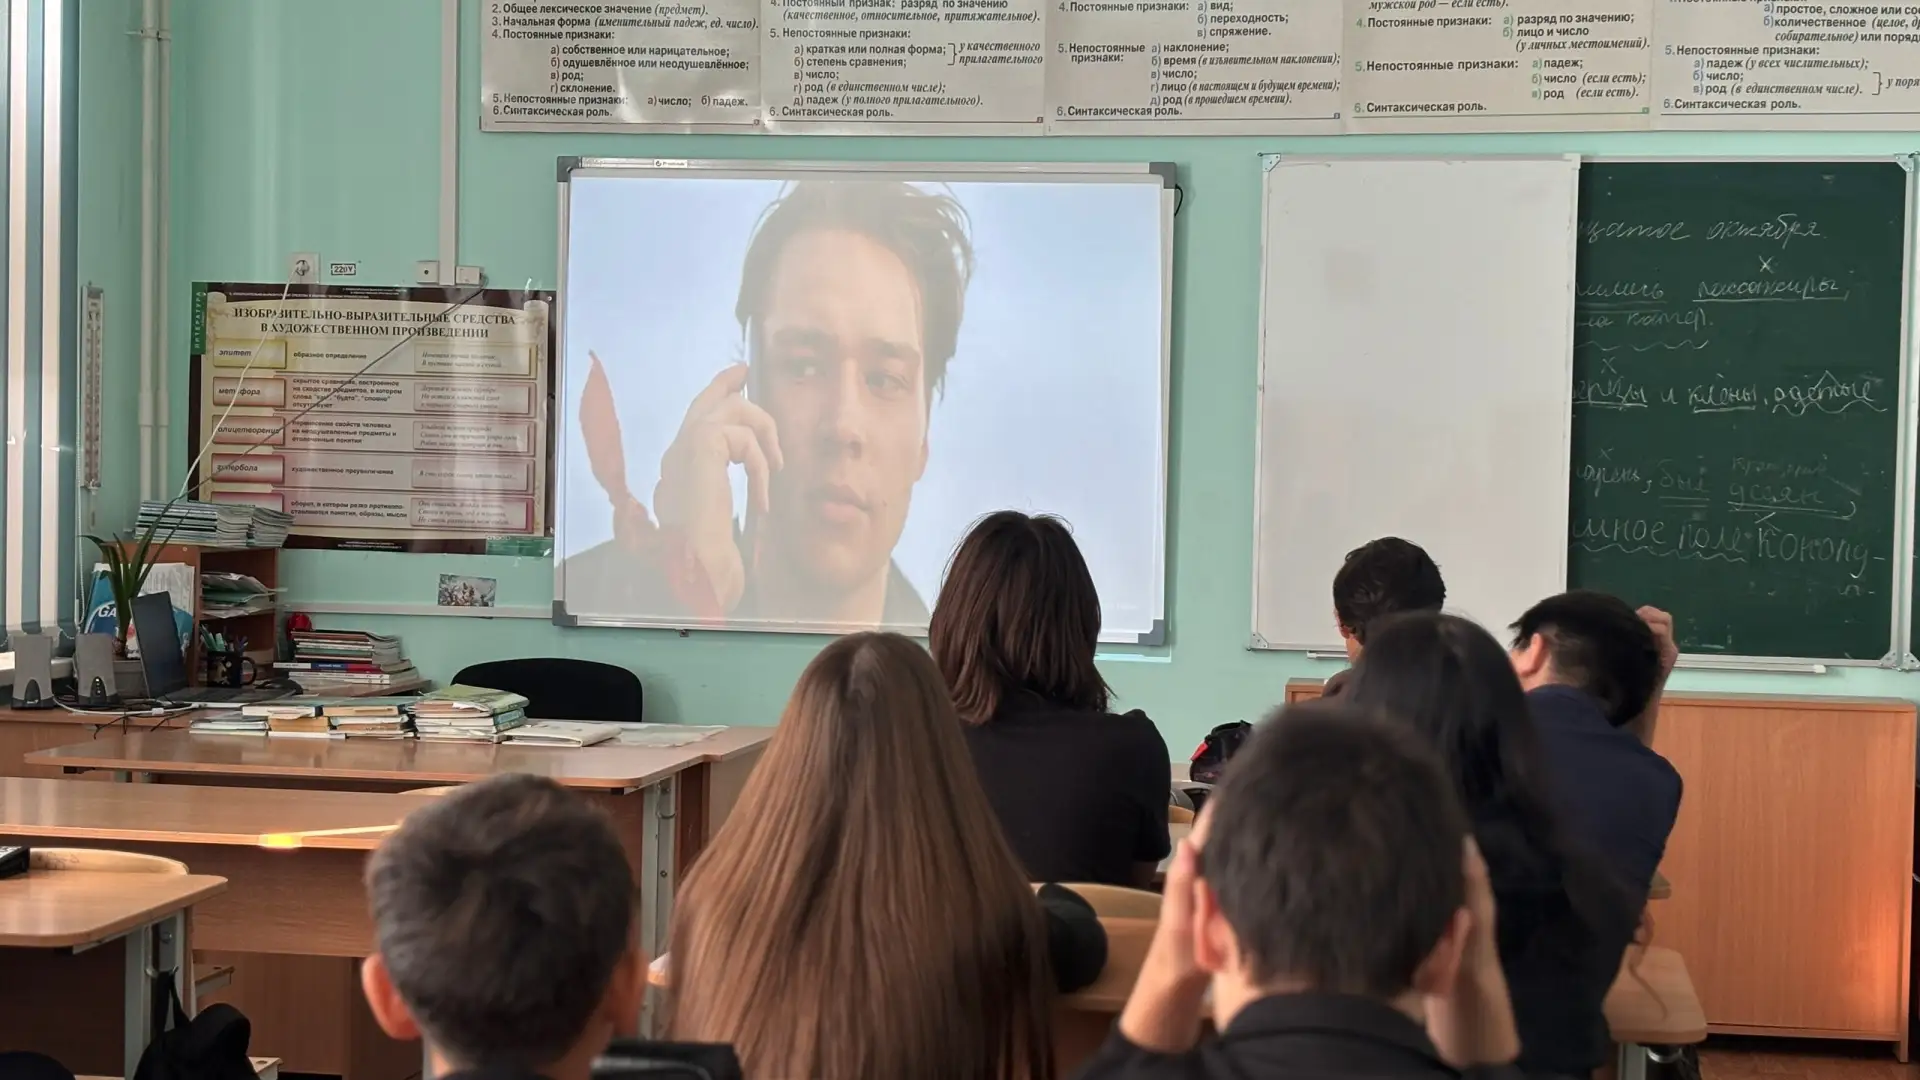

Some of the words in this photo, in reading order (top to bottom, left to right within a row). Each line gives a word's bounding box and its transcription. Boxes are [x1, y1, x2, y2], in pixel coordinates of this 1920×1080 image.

[503, 5, 538, 15] Общее
[539, 6, 602, 16] лексическое
[604, 6, 652, 15] значение
[655, 5, 708, 16] (предмет).
[1070, 1, 1134, 12] Постоянные
[1136, 3, 1189, 13] признаки:
[1210, 2, 1233, 12] вид;
[1776, 5, 1827, 16] простое,
[1829, 6, 1878, 16] сложное
[1881, 7, 1902, 16] или
[783, 10, 858, 22] (качественное,
[861, 12, 940, 22] относительное,
[944, 10, 1040, 23] притяжательное).
[1210, 14, 1288, 25] переходность;
[1368, 18, 1434, 27] Постоянные
[1437, 17, 1491, 27] признаки:
[1517, 16, 1557, 27] разряд
[1559, 15, 1573, 23] по
[1575, 14, 1634, 24] значению;
[503, 17, 555, 26] Начальная
[557, 17, 590, 28] форма
[595, 17, 671, 27] (именительный
[673, 17, 707, 29] падеж,
[710, 17, 723, 28] ед.
[726, 18, 760, 29] число).
[1773, 19, 1866, 28] количественное
[1872, 17, 1908, 29] (целое,
[503, 30, 563, 39] Постоянные
[565, 31, 615, 41] признаки:
[783, 28, 857, 38] Непостоянные
[859, 30, 910, 39] признаки:
[1209, 28, 1271, 38] спряжение.
[1517, 28, 1544, 38] лицо
[1556, 28, 1589, 36] число
[1775, 30, 1859, 43] собирательное)
[964, 43, 1040, 51] качественного
[1069, 43, 1145, 53] Непостоянные
[1164, 44, 1229, 53] наклонение;
[1528, 41, 1566, 50] личных
[1568, 38, 1650, 50] местоимений).
[562, 45, 626, 54] собственное
[626, 47, 646, 56] или
[649, 47, 729, 57] нарицательное;
[806, 46, 846, 56] краткая
[848, 46, 867, 54] или
[869, 46, 905, 54] полная
[906, 44, 946, 56] форма;
[1677, 45, 1759, 55] Непостоянные
[1762, 47, 1820, 56] признаки:
[563, 58, 636, 69] одушевлённое
[638, 60, 657, 68] или
[660, 59, 749, 70] неодушевлённое;
[807, 59, 847, 67] степень
[849, 59, 906, 68] сравнения;
[959, 56, 1043, 66] прилагательного
[1071, 54, 1124, 63] признаки:
[1164, 57, 1196, 67] время
[1280, 53, 1340, 65] наклонении);
[1706, 60, 1743, 69] падеж
[1758, 60, 1781, 68] всех
[1784, 58, 1869, 70] числительных);
[1367, 61, 1454, 71] Непостоянные
[1457, 60, 1518, 71] признаки:
[1544, 60, 1583, 69] падеж;
[562, 72, 584, 82] род;
[806, 71, 839, 80] число;
[1163, 70, 1197, 80] число;
[1544, 75, 1577, 83] число
[1582, 72, 1610, 85] (если
[1612, 72, 1646, 84] есть);
[1706, 72, 1743, 82] число;
[560, 85, 615, 93] склонение.
[804, 84, 823, 93] род
[838, 82, 909, 92] единственном
[912, 82, 946, 94] числе);
[1161, 84, 1187, 93] лицо
[1297, 81, 1340, 93] времени);
[1544, 90, 1564, 99] род
[1576, 86, 1604, 99] (если
[1605, 86, 1639, 99] есть).
[1705, 85, 1728, 96] род
[1746, 83, 1823, 94] единственном
[1826, 83, 1863, 96] числе).
[504, 94, 576, 104] Непостоянные
[579, 97, 628, 106] признаки:
[658, 98, 691, 107] число;
[713, 99, 748, 107] падеж.
[805, 95, 838, 106] падеж
[853, 96, 891, 104] полного
[893, 95, 983, 107] прилагательного).
[1163, 96, 1182, 106] род
[1248, 93, 1292, 106] времени).
[1674, 99, 1767, 109] Синтаксическая
[1770, 101, 1801, 110] роль.
[503, 106, 584, 116] Синтаксическая
[586, 109, 612, 118] роль.
[782, 107, 864, 116] Синтаксическая
[866, 109, 893, 119] роль.
[1068, 106, 1152, 116] Синтаксическая
[1154, 107, 1182, 117] роль.
[1367, 102, 1455, 112] Синтаксическая
[1457, 103, 1487, 113] роль.
[234, 308, 450, 324] ИЗОБРАЗИТЕЛЬНО-ВЫРАЗИТЕЛЬНЫЕ
[453, 313, 516, 325] СРЕДСТВА
[260, 323, 268, 332] В
[271, 323, 389, 336] ХУДОЖЕСТВЕННОМ
[392, 326, 489, 338] ПРОИЗВЕДЕНИИ
[218, 349, 252, 357] эпитет
[218, 388, 261, 396] метфора
[217, 426, 280, 435] олицетворение
[216, 464, 258, 472] гипербола
